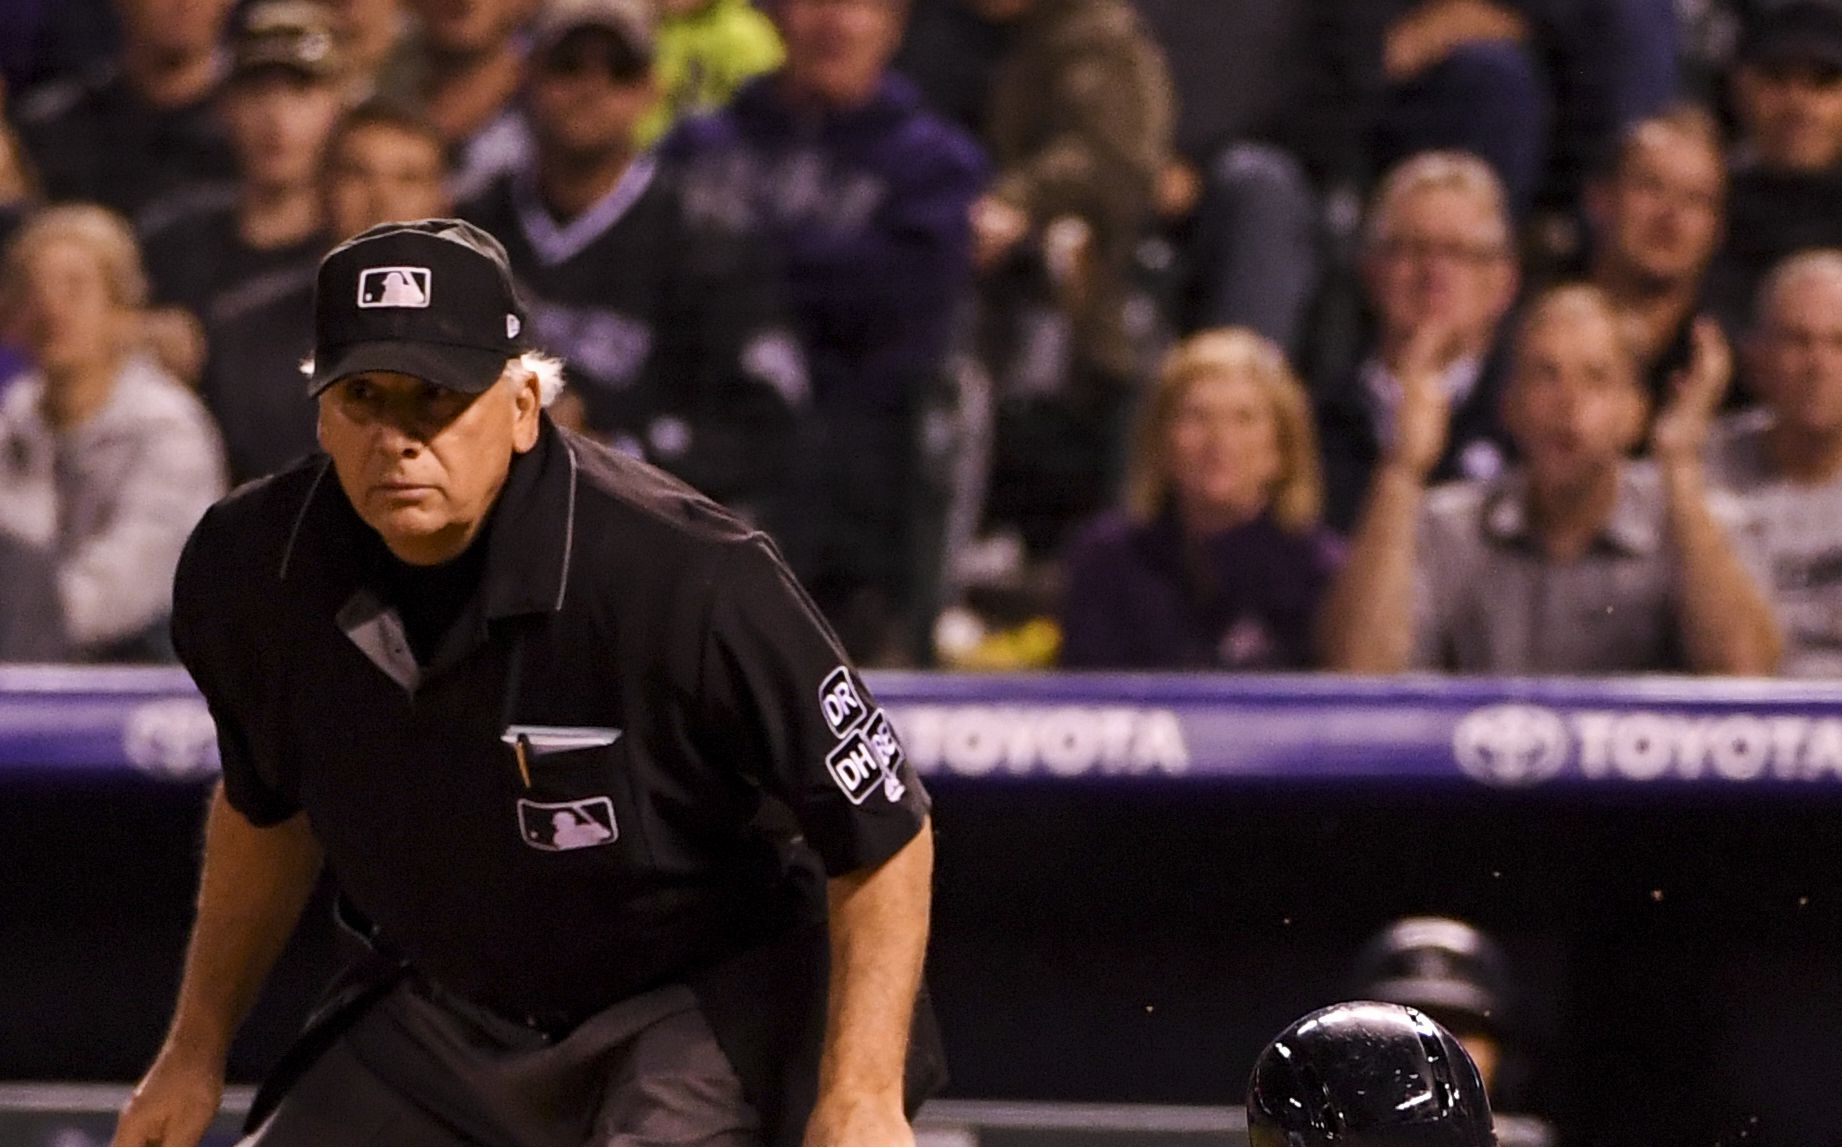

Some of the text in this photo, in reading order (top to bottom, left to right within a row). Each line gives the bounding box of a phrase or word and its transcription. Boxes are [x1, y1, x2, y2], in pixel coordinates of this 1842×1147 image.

[822, 682, 858, 727] DR
[904, 705, 1190, 776] TOYOTA
[836, 743, 877, 791] DH
